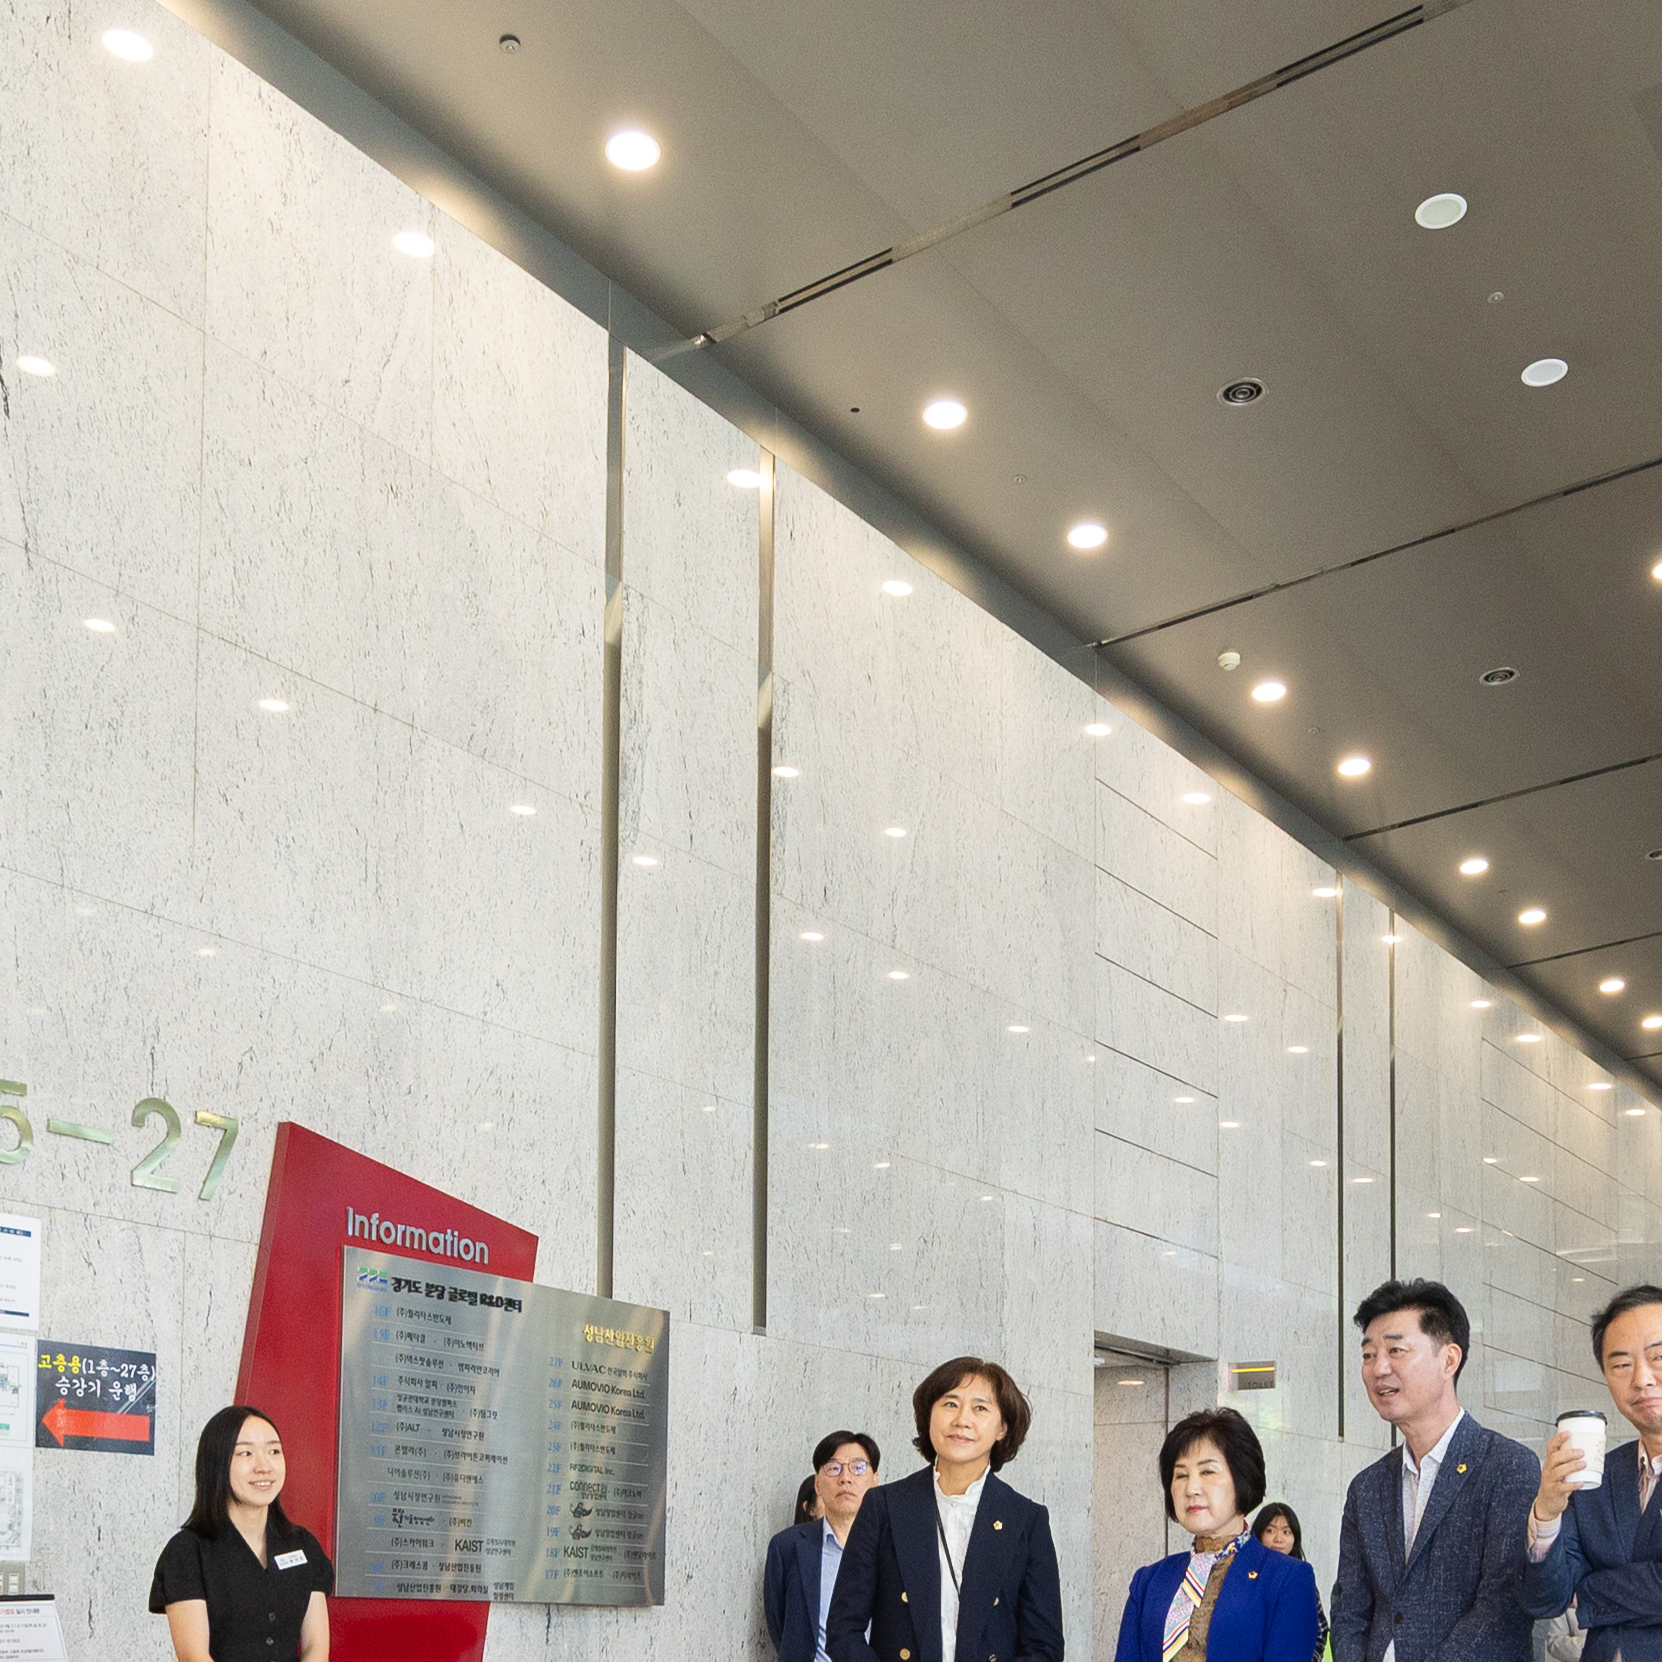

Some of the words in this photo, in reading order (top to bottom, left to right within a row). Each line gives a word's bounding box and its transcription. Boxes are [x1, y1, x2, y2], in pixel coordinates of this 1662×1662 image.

[347, 1206, 489, 1264] Information
[391, 1276, 423, 1294] 경기도
[424, 1282, 447, 1300] 분당
[448, 1287, 478, 1306] 글로벌
[582, 1323, 655, 1354] 성남산업진흥원
[571, 1360, 606, 1374] ULVAC
[54, 1377, 101, 1398] 승강기
[108, 1381, 138, 1402] 운행
[571, 1379, 610, 1394] AUMOVIO
[611, 1385, 632, 1397] Korea
[632, 1389, 646, 1399] Ltd.
[571, 1400, 610, 1414] AUMOVIO
[610, 1406, 632, 1418] Korea
[632, 1409, 646, 1420] Ltd.
[454, 1538, 485, 1553] KAIST
[563, 1545, 589, 1559] KAIST
